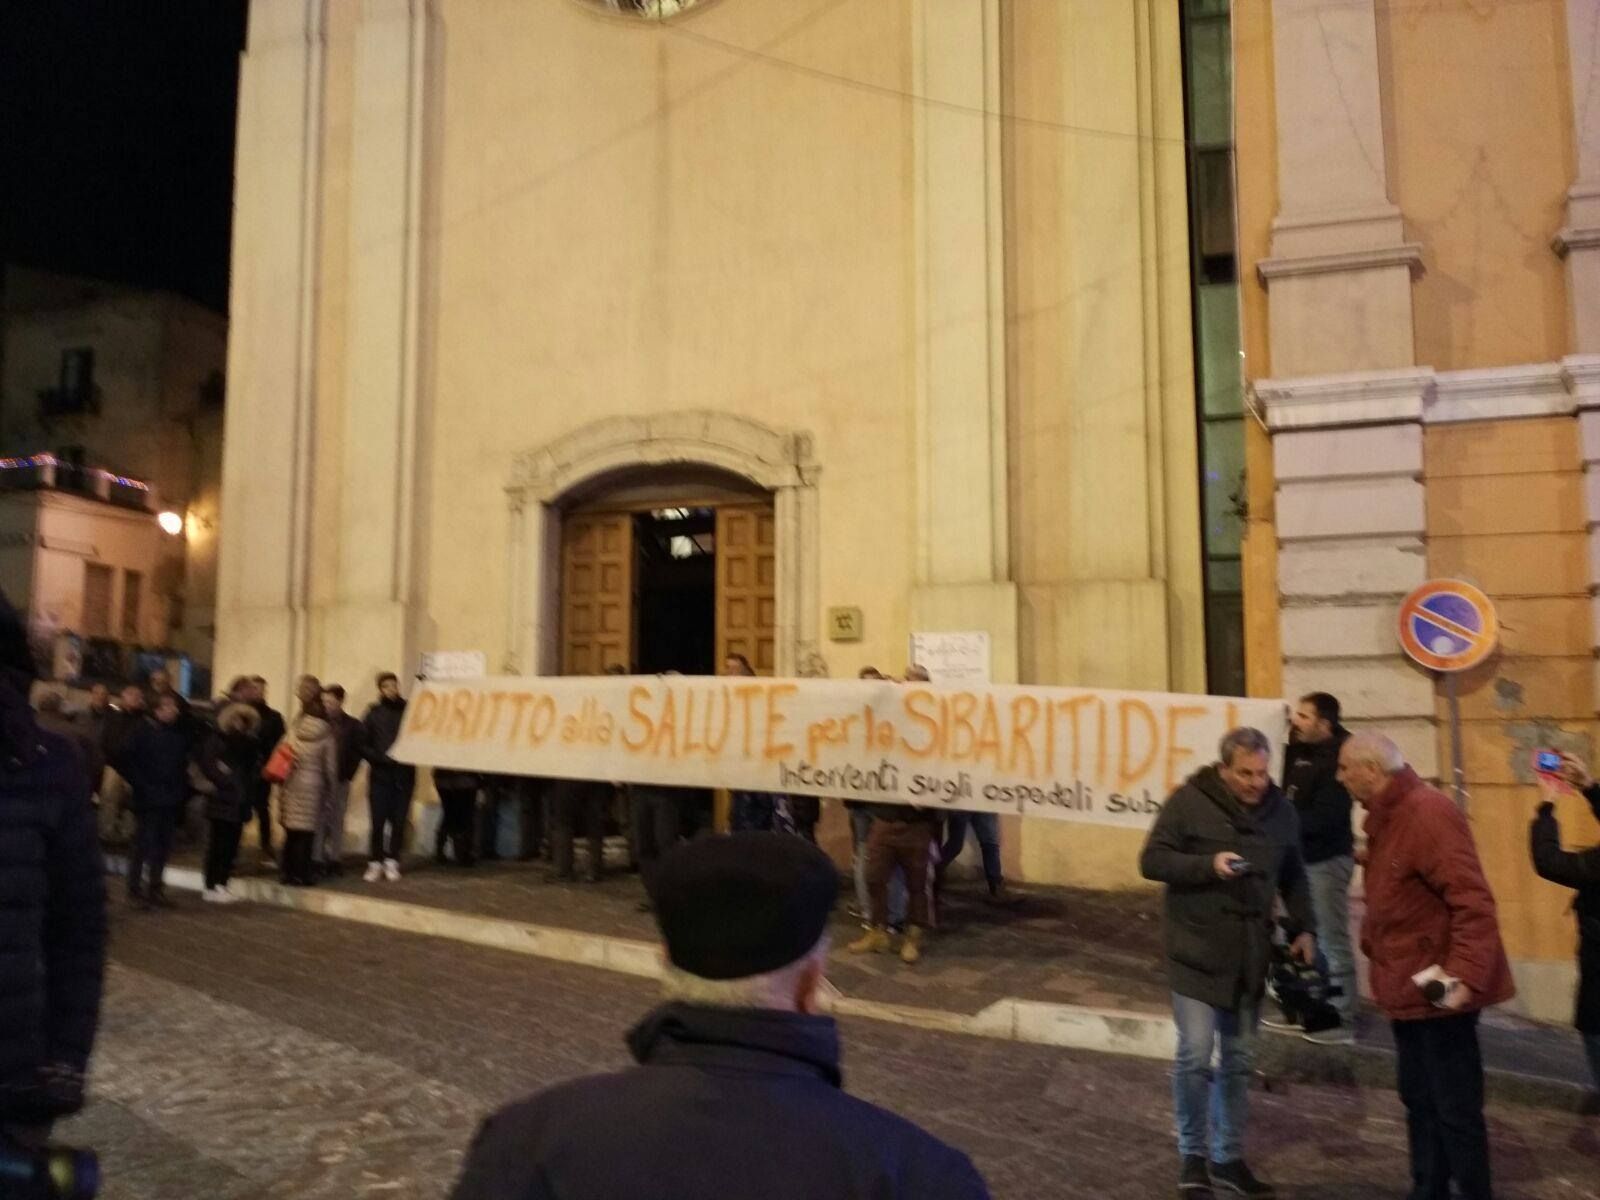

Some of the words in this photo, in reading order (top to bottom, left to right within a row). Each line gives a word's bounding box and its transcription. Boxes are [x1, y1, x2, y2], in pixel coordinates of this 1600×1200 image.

[407, 688, 557, 749] DIRITTO
[560, 695, 615, 745] alla
[620, 683, 798, 760] SALUTE
[807, 714, 860, 766] per
[864, 703, 895, 751] la
[907, 770, 973, 804] sugli
[982, 779, 1093, 813] ospedali
